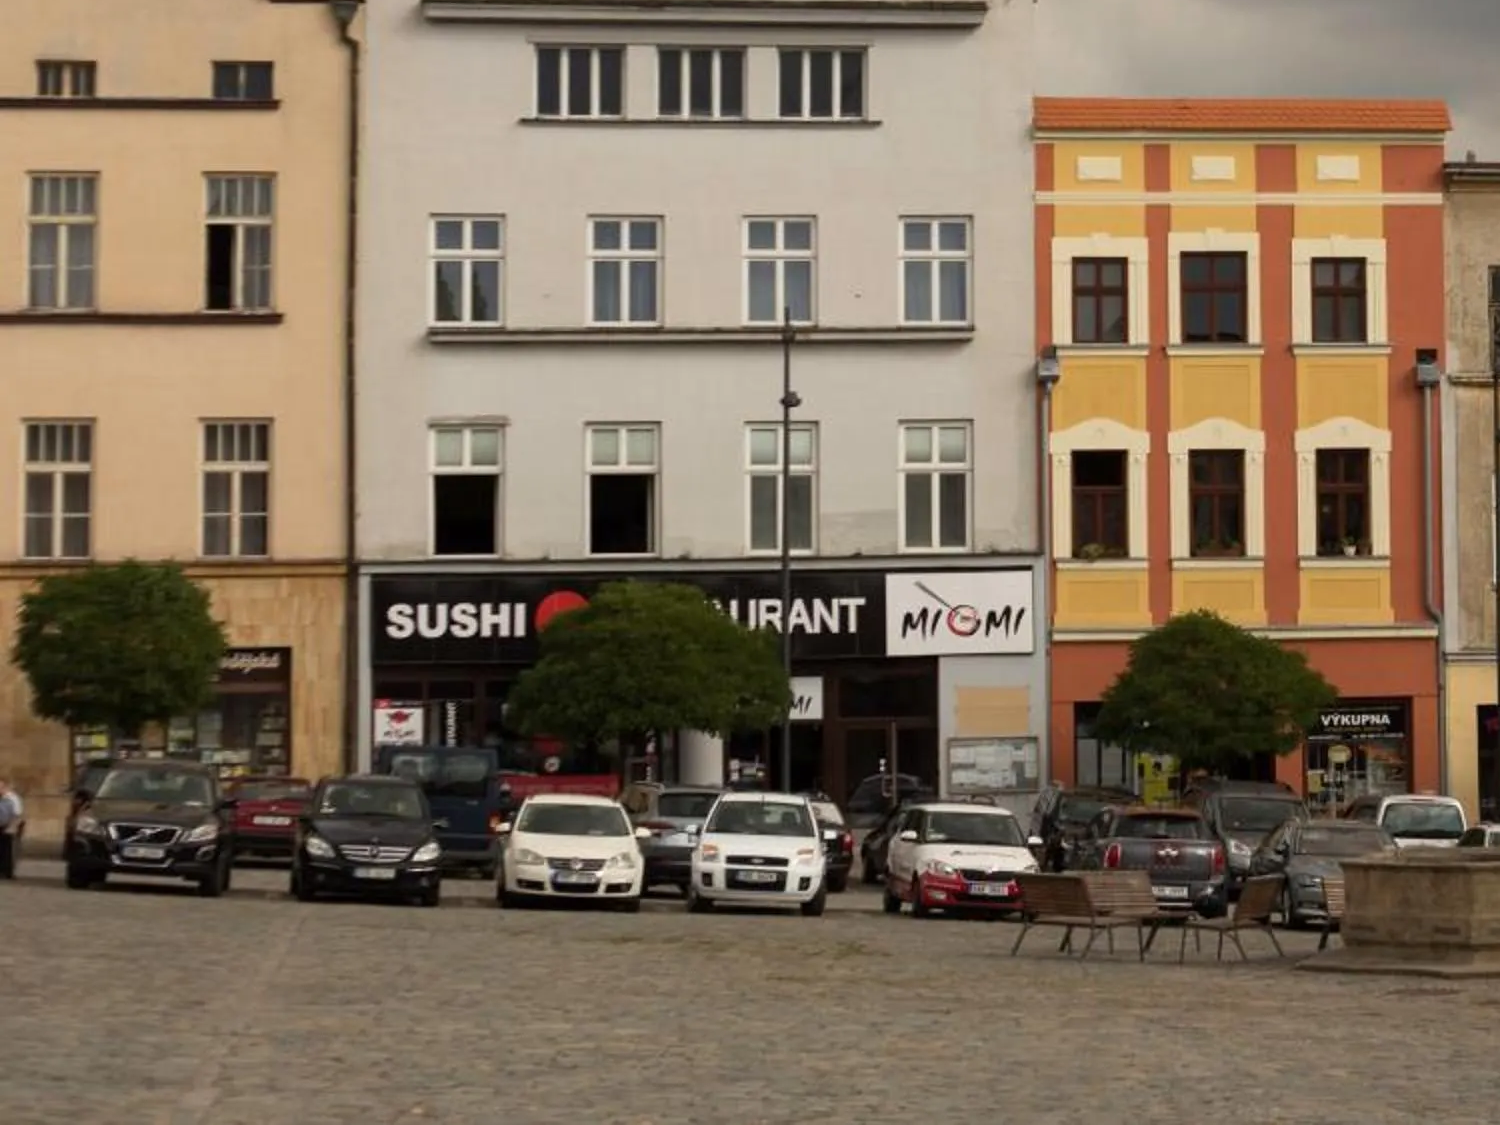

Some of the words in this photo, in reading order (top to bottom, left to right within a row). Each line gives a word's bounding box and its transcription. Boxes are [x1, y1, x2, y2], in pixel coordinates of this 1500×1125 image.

[386, 602, 527, 639] SUSHI
[704, 597, 867, 634] URANT
[902, 604, 1025, 641] MIOMI
[1320, 712, 1391, 726] VÝKUPNA
